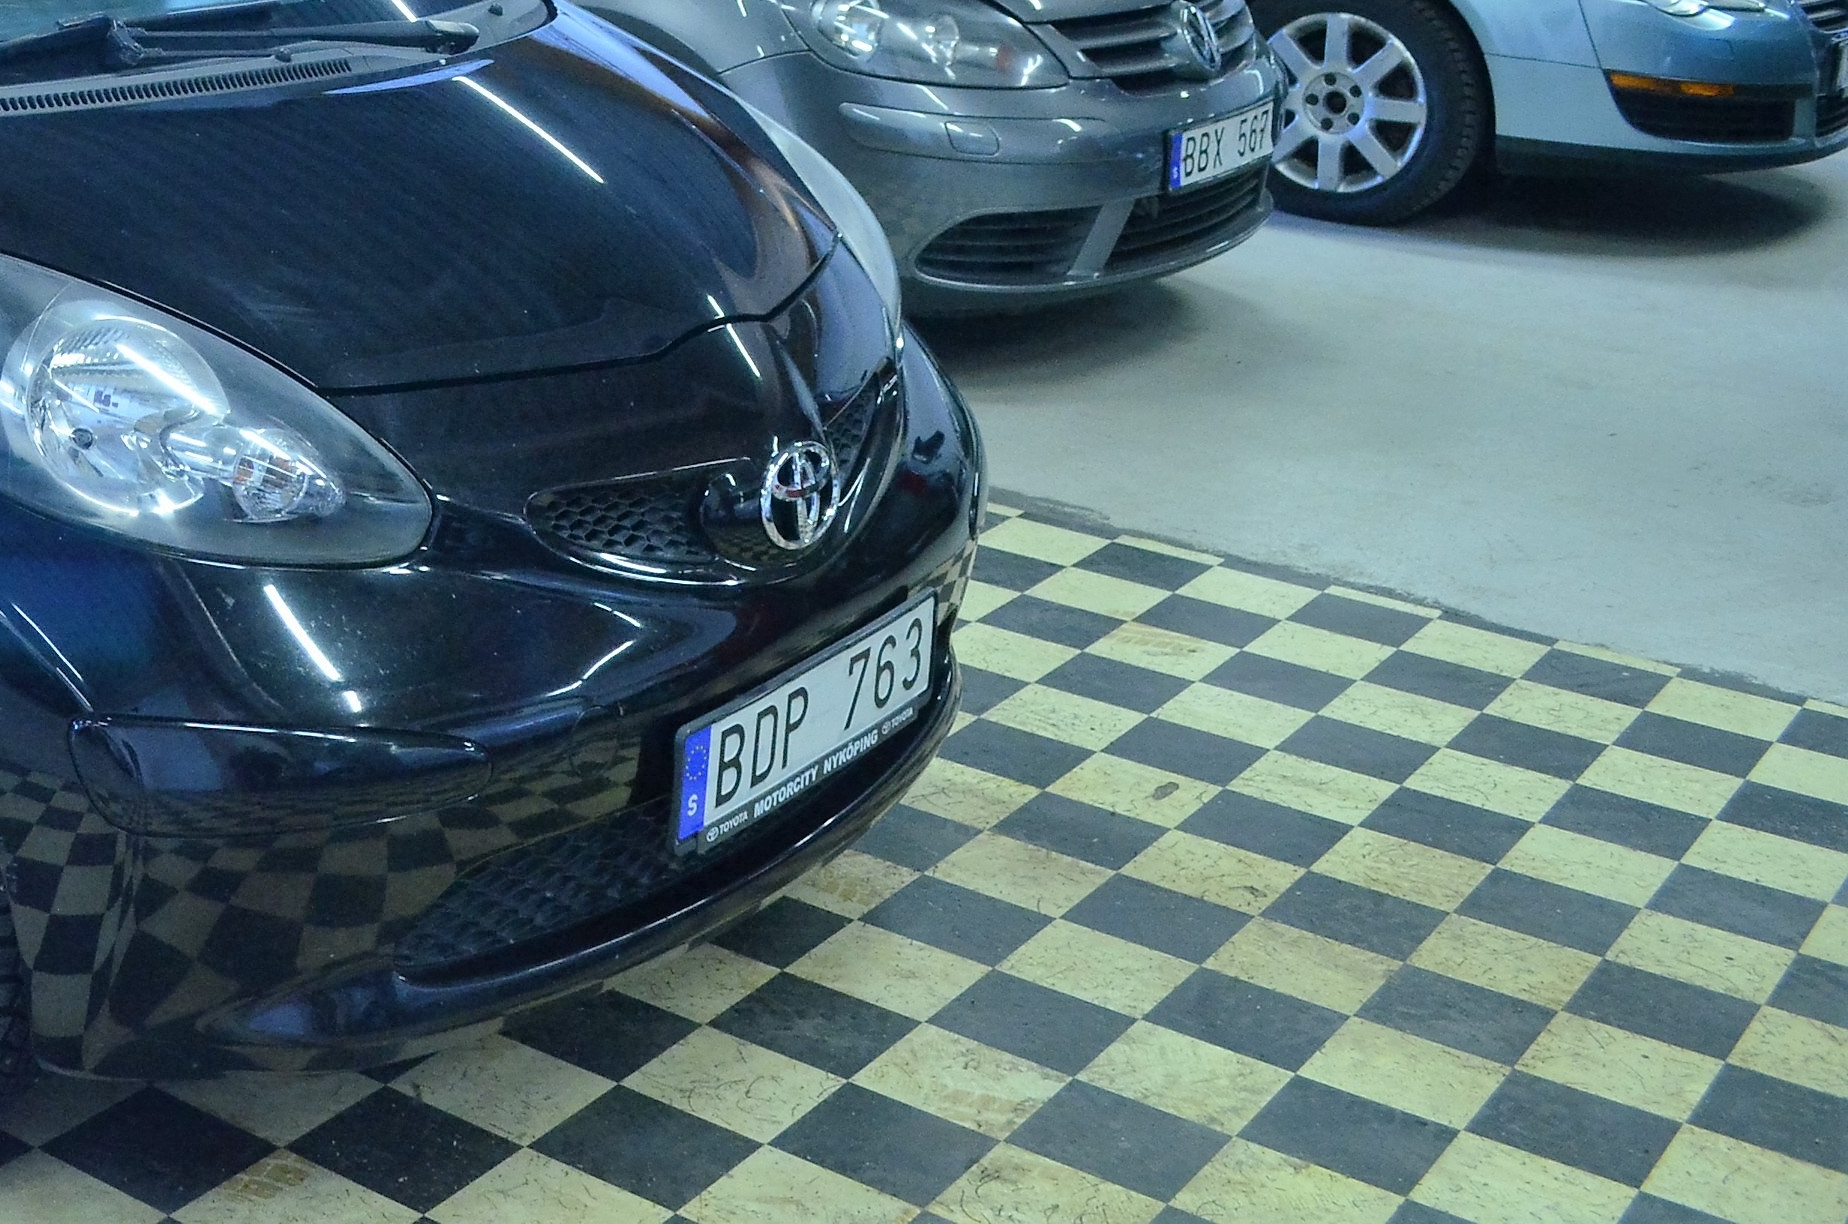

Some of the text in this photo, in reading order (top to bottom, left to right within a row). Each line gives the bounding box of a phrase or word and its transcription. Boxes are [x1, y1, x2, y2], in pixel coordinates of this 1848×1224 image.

[1184, 109, 1269, 177] BBX 567
[715, 617, 923, 809] BDP 763
[687, 793, 698, 816] S
[719, 707, 914, 835] TOYOTA MOTORCITY NYKÖPING TOYOTA
